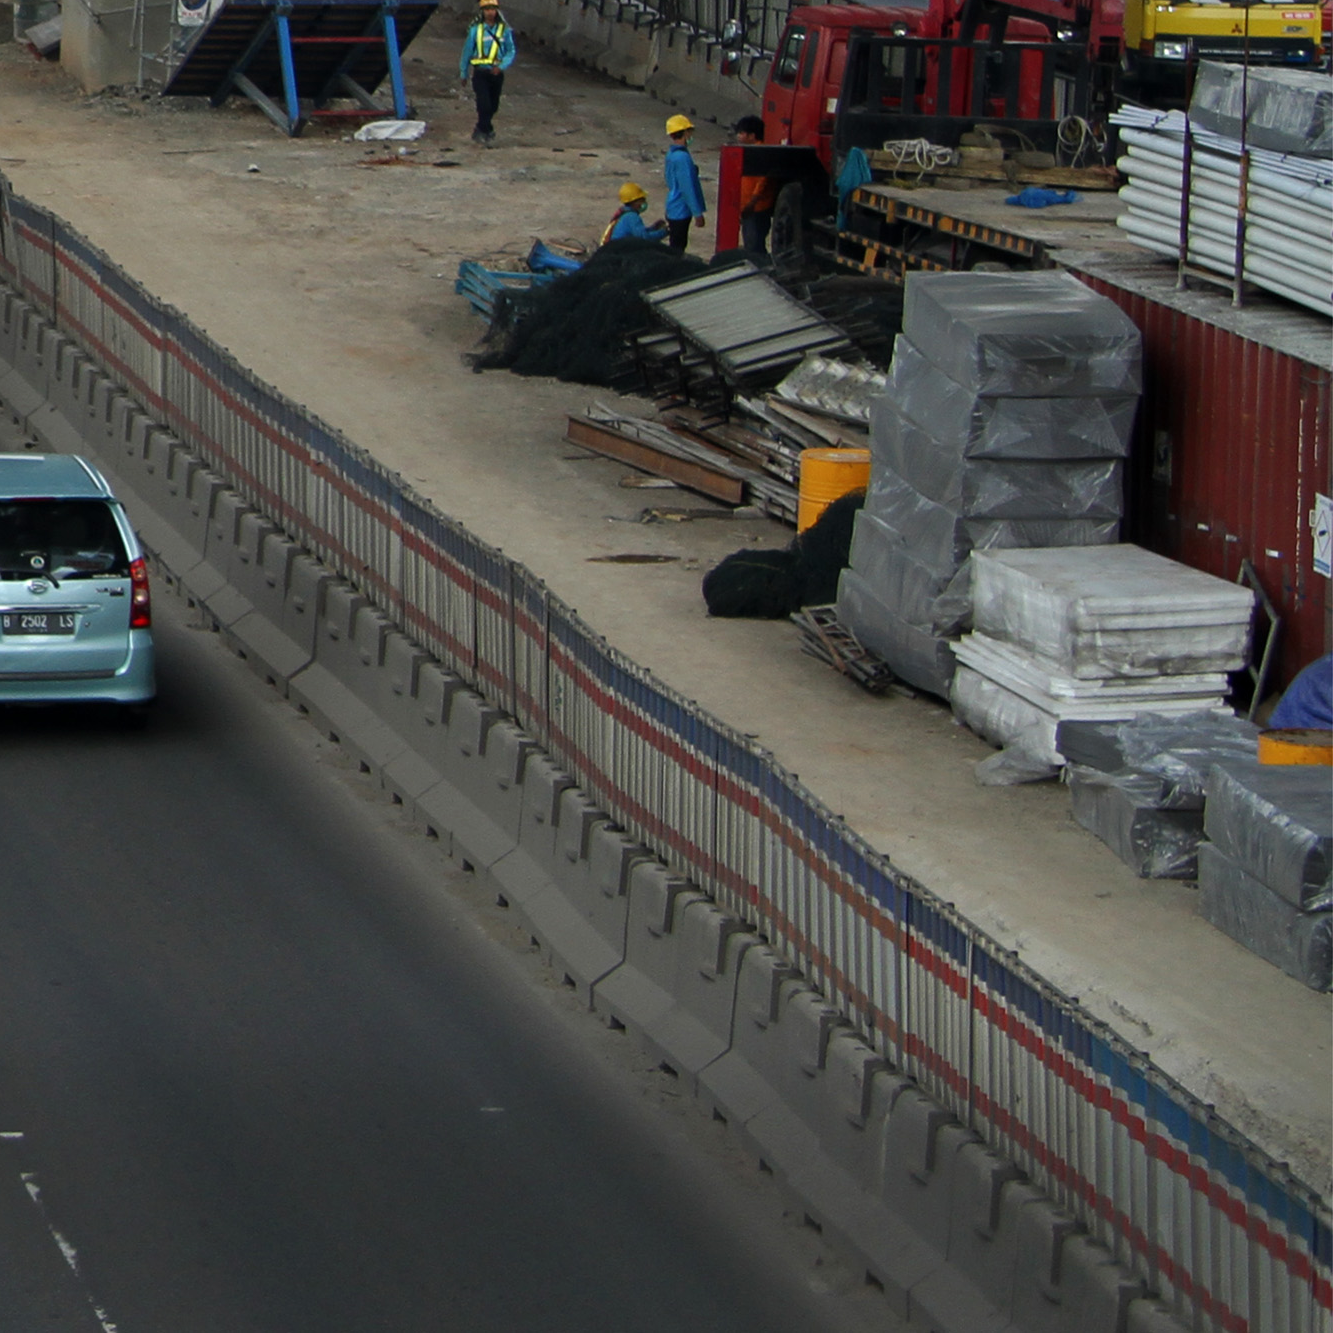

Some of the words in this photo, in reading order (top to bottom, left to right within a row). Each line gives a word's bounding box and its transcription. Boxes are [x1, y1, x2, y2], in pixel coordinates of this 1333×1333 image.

[3, 616, 11, 628] B
[21, 615, 48, 628] 2502
[59, 615, 74, 627] LS
